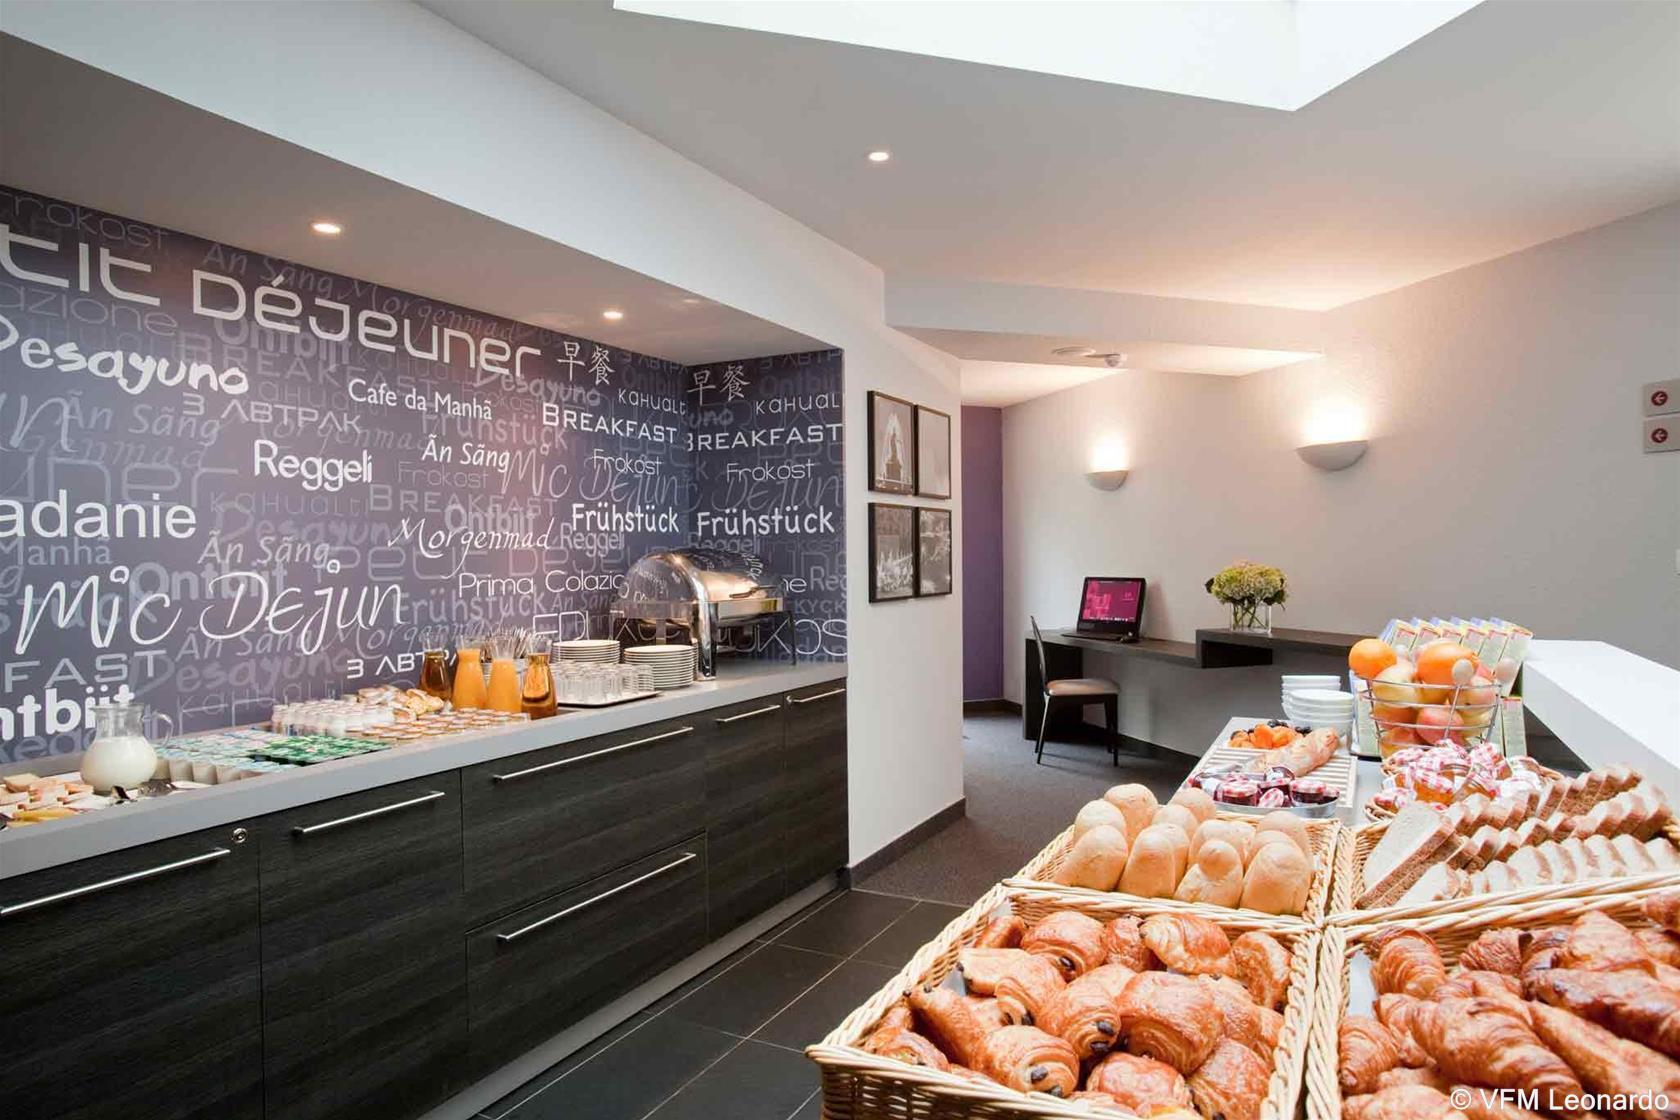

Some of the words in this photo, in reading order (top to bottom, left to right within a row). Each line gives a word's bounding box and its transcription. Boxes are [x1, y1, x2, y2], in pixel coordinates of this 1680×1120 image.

[556, 340, 616, 387] 早餐
[687, 363, 752, 407] 早餐
[347, 377, 398, 407] Cafe
[404, 387, 427, 412] da
[434, 391, 493, 422] Manhã
[542, 401, 678, 445] BREAKFAST
[253, 438, 374, 493] Reggeli
[592, 447, 664, 477] Frokost
[726, 458, 816, 483] Frokost
[572, 501, 680, 534] Frühstück
[696, 504, 836, 537] Frühstück
[387, 516, 555, 580] Morgenmad
[458, 572, 534, 598] Prima
[15, 565, 183, 656] Mic
